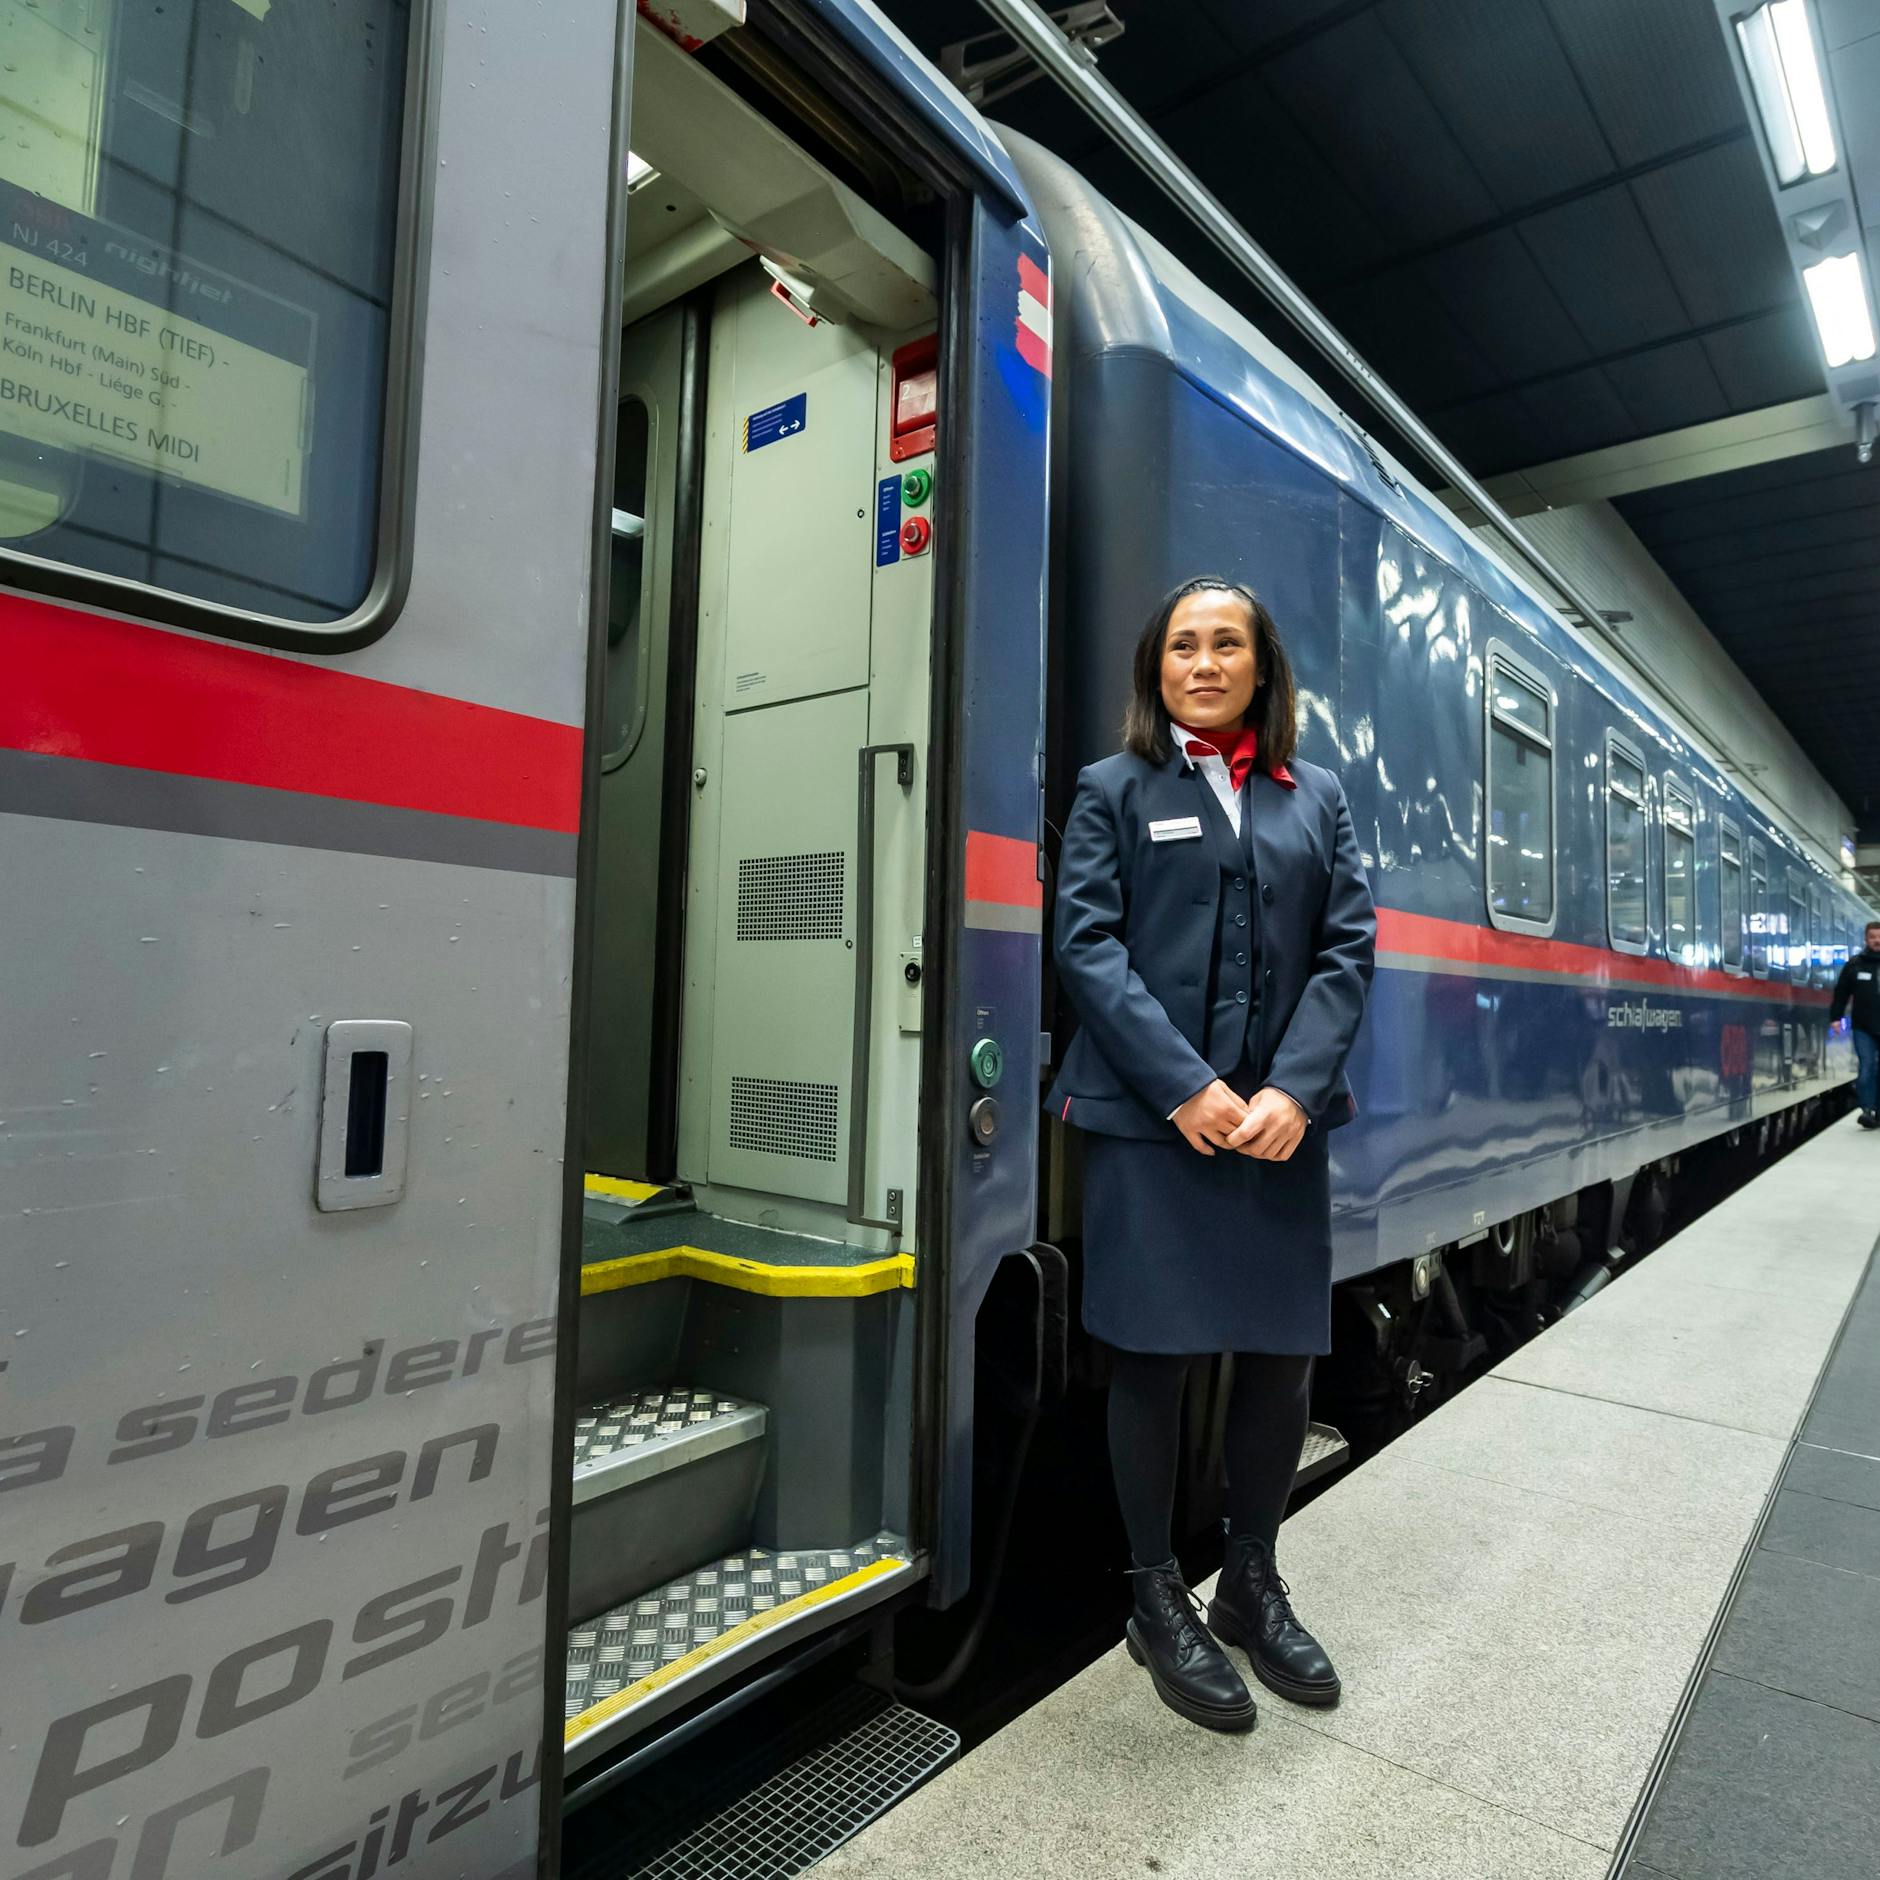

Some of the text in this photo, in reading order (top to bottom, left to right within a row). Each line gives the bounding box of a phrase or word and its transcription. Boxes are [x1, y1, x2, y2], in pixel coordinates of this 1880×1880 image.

[13, 222, 88, 268] NJ 424
[104, 241, 233, 304] nightjet
[5, 311, 87, 355] Frankfurt
[92, 344, 145, 377] (Main)
[150, 367, 180, 390] Süd
[9, 266, 96, 319] BERLIN
[105, 305, 151, 339] HBF
[159, 327, 215, 368] (TIEF)
[2, 337, 43, 364] Köln
[50, 353, 83, 377] Hbf
[0, 377, 200, 463] BRUXELLES MIDI
[1608, 997, 1683, 1034] schlafwagen
[107, 1317, 557, 1466] sedere
[0, 1423, 500, 1626] agen
